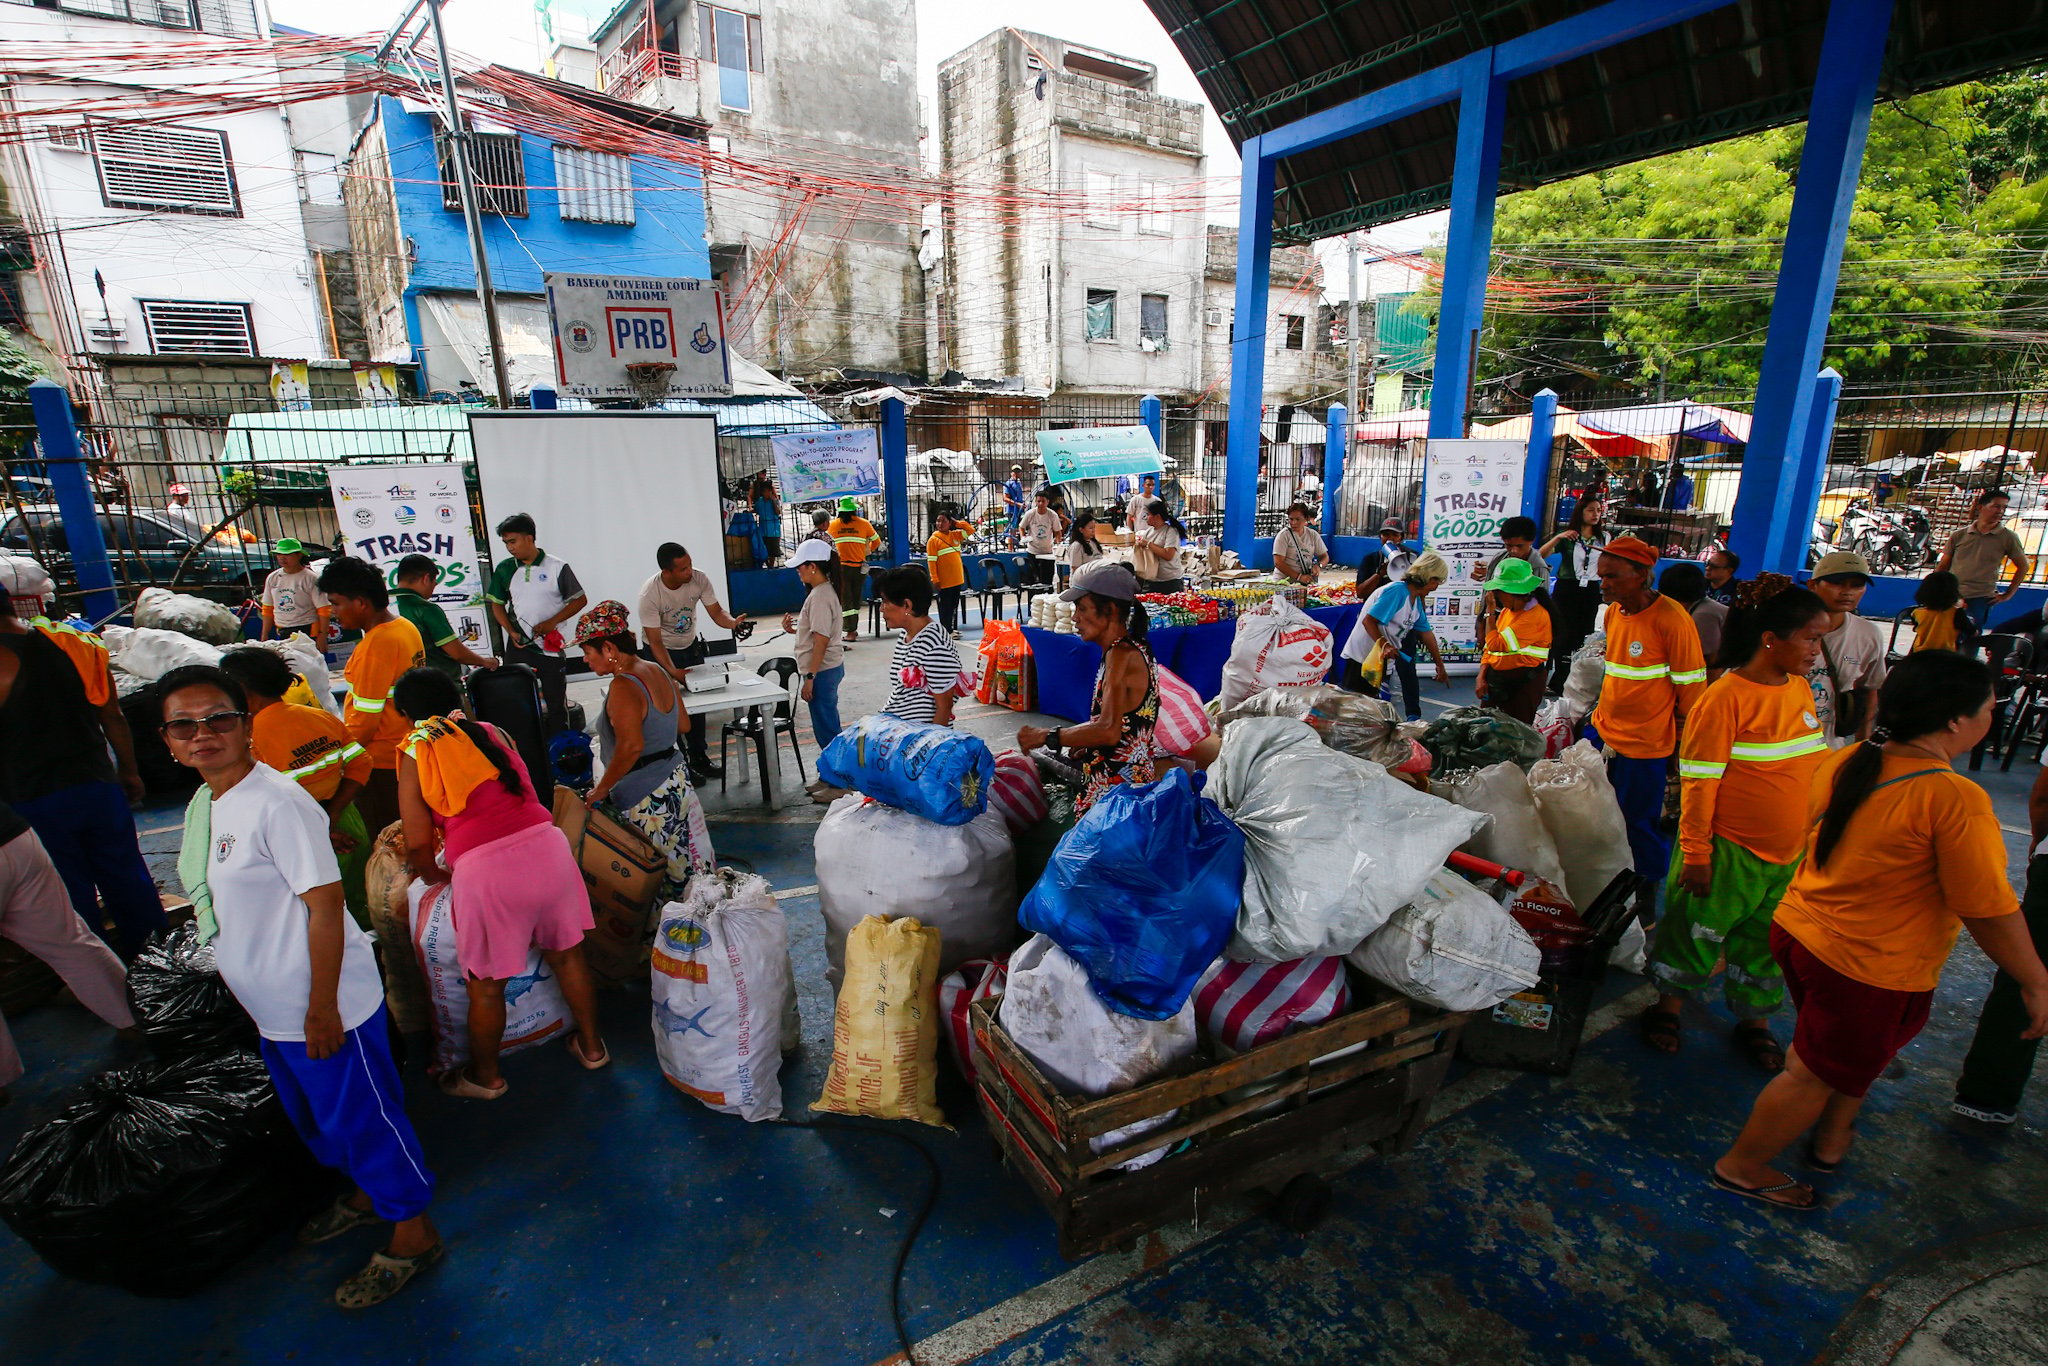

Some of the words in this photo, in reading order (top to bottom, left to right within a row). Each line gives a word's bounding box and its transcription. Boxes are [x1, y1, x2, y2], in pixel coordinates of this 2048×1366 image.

[567, 278, 609, 288] BASECO
[614, 280, 662, 290] COVERED
[667, 281, 700, 292] COURT
[607, 290, 668, 301] AMADOME
[616, 318, 667, 349] PRB
[802, 458, 844, 468] ENVIRONMENTAL
[1434, 492, 1508, 513] TRASH
[355, 532, 454, 561] TRASH
[292, 736, 329, 757] BARANGAY
[288, 754, 316, 770] STREET
[1527, 902, 1562, 916] Flavor
[426, 925, 440, 963] PREMIUM
[433, 966, 447, 1000] BANGUS
[736, 977, 750, 1022] FINISHER
[508, 1018, 526, 1030] eight
[738, 1024, 750, 1056] BANGUS
[856, 1052, 882, 1073] JF
[856, 1076, 882, 1108] Code:
